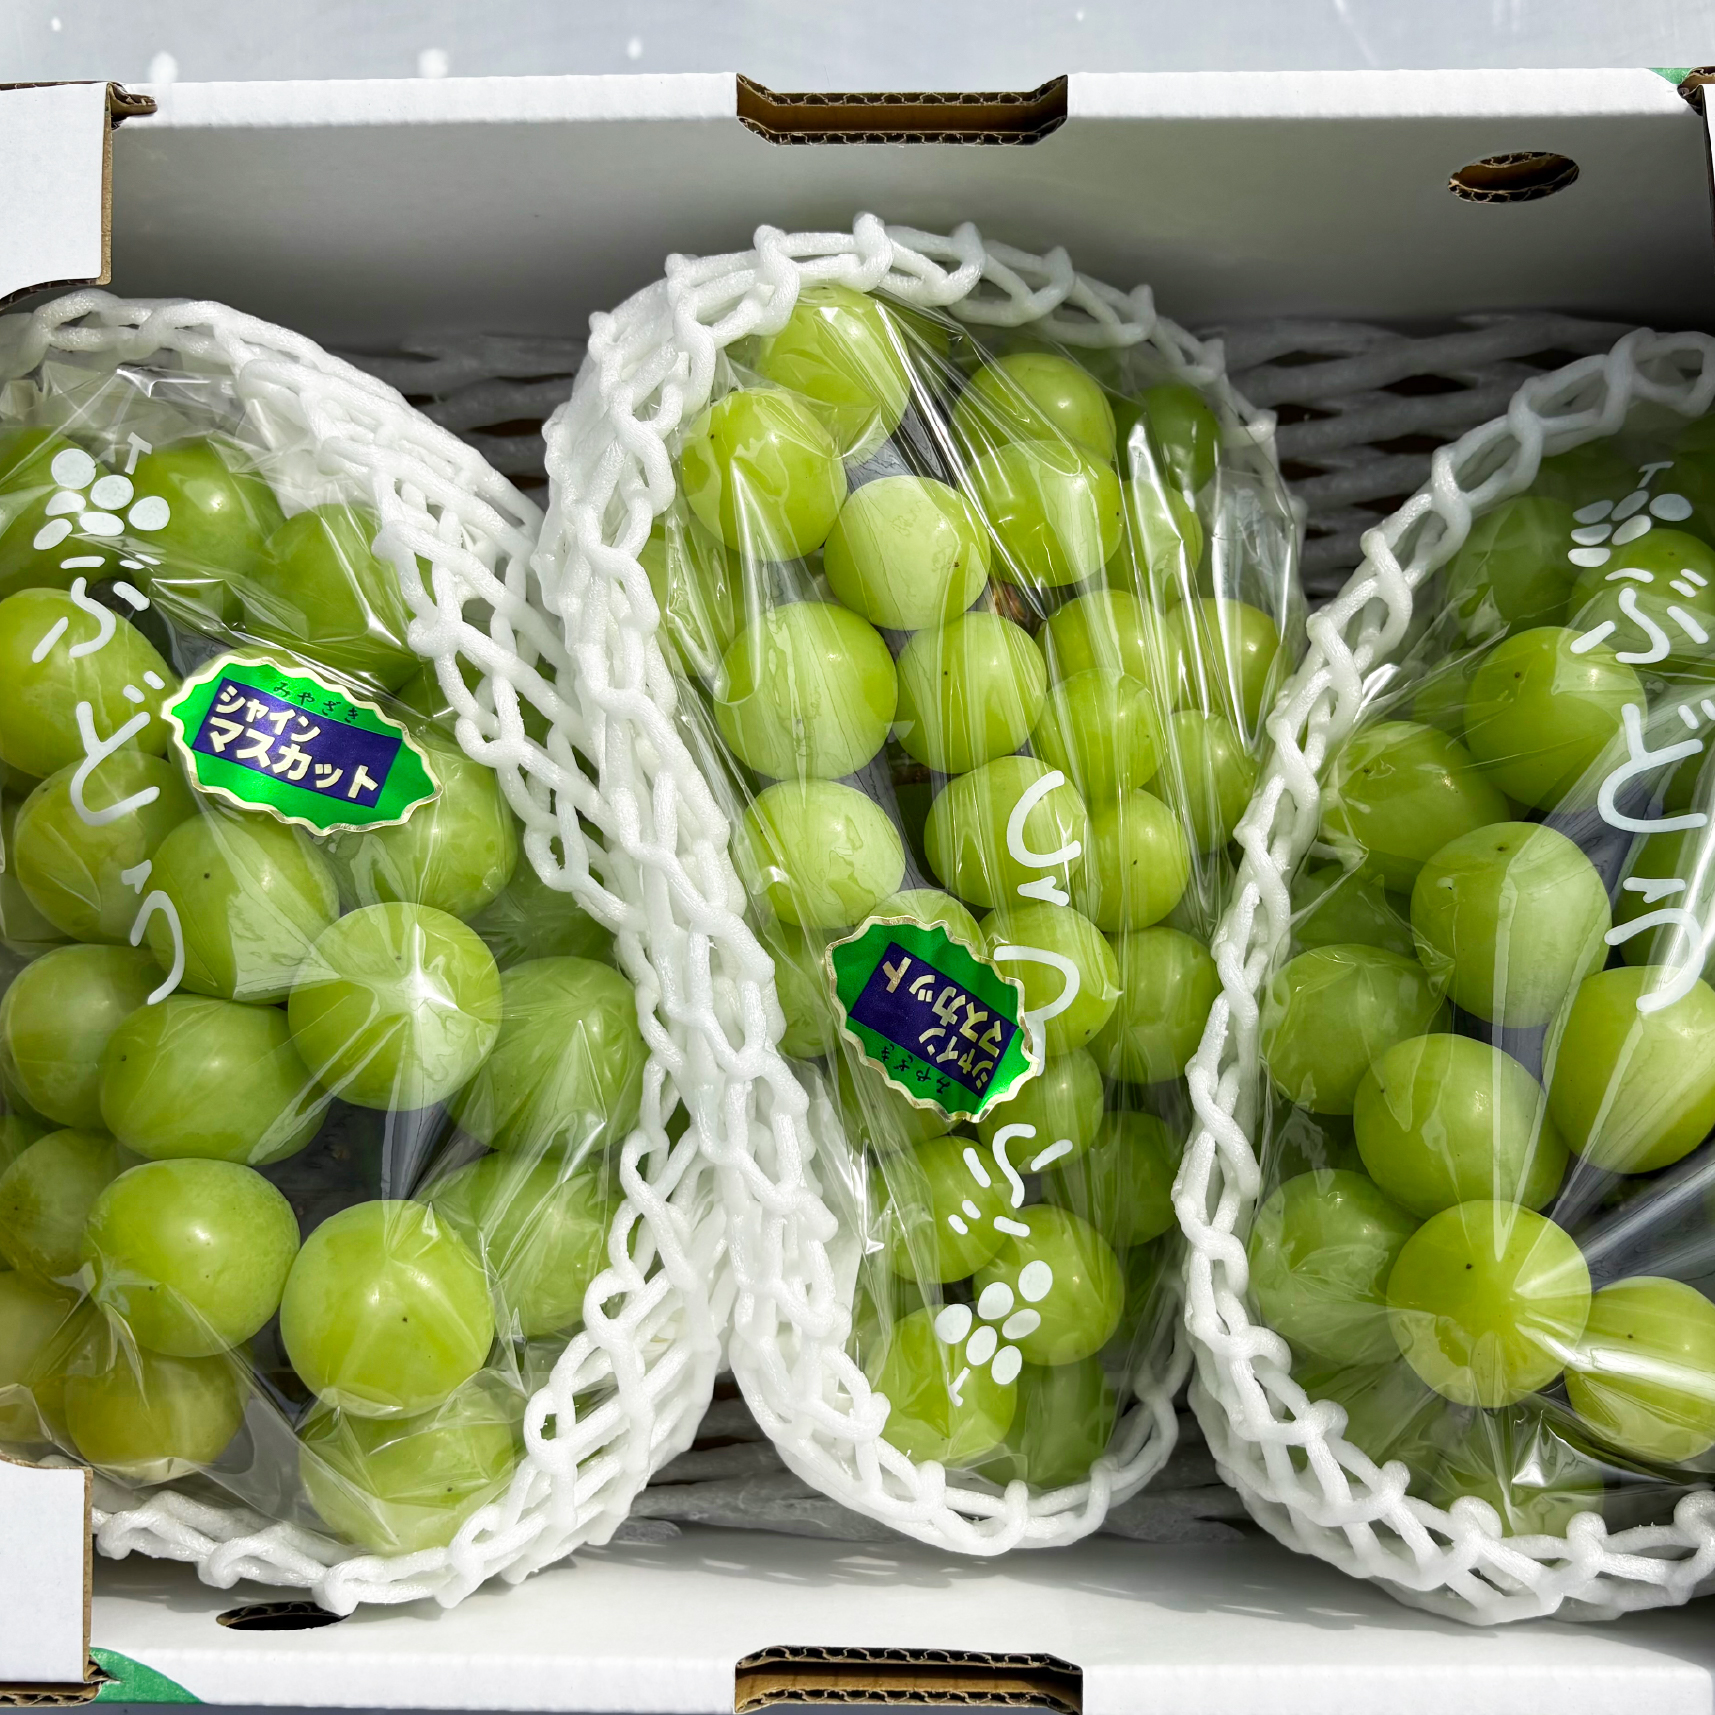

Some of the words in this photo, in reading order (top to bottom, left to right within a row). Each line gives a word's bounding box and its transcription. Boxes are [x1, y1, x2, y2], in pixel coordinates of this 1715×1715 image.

[215, 685, 321, 742] シャイン
[273, 682, 359, 724] みやざき
[32, 555, 184, 1005] ぶどう
[209, 717, 379, 799] マスカット
[882, 956, 1002, 1057] マスカット
[881, 1044, 951, 1095] みやざき
[918, 1027, 994, 1090] シャイン
